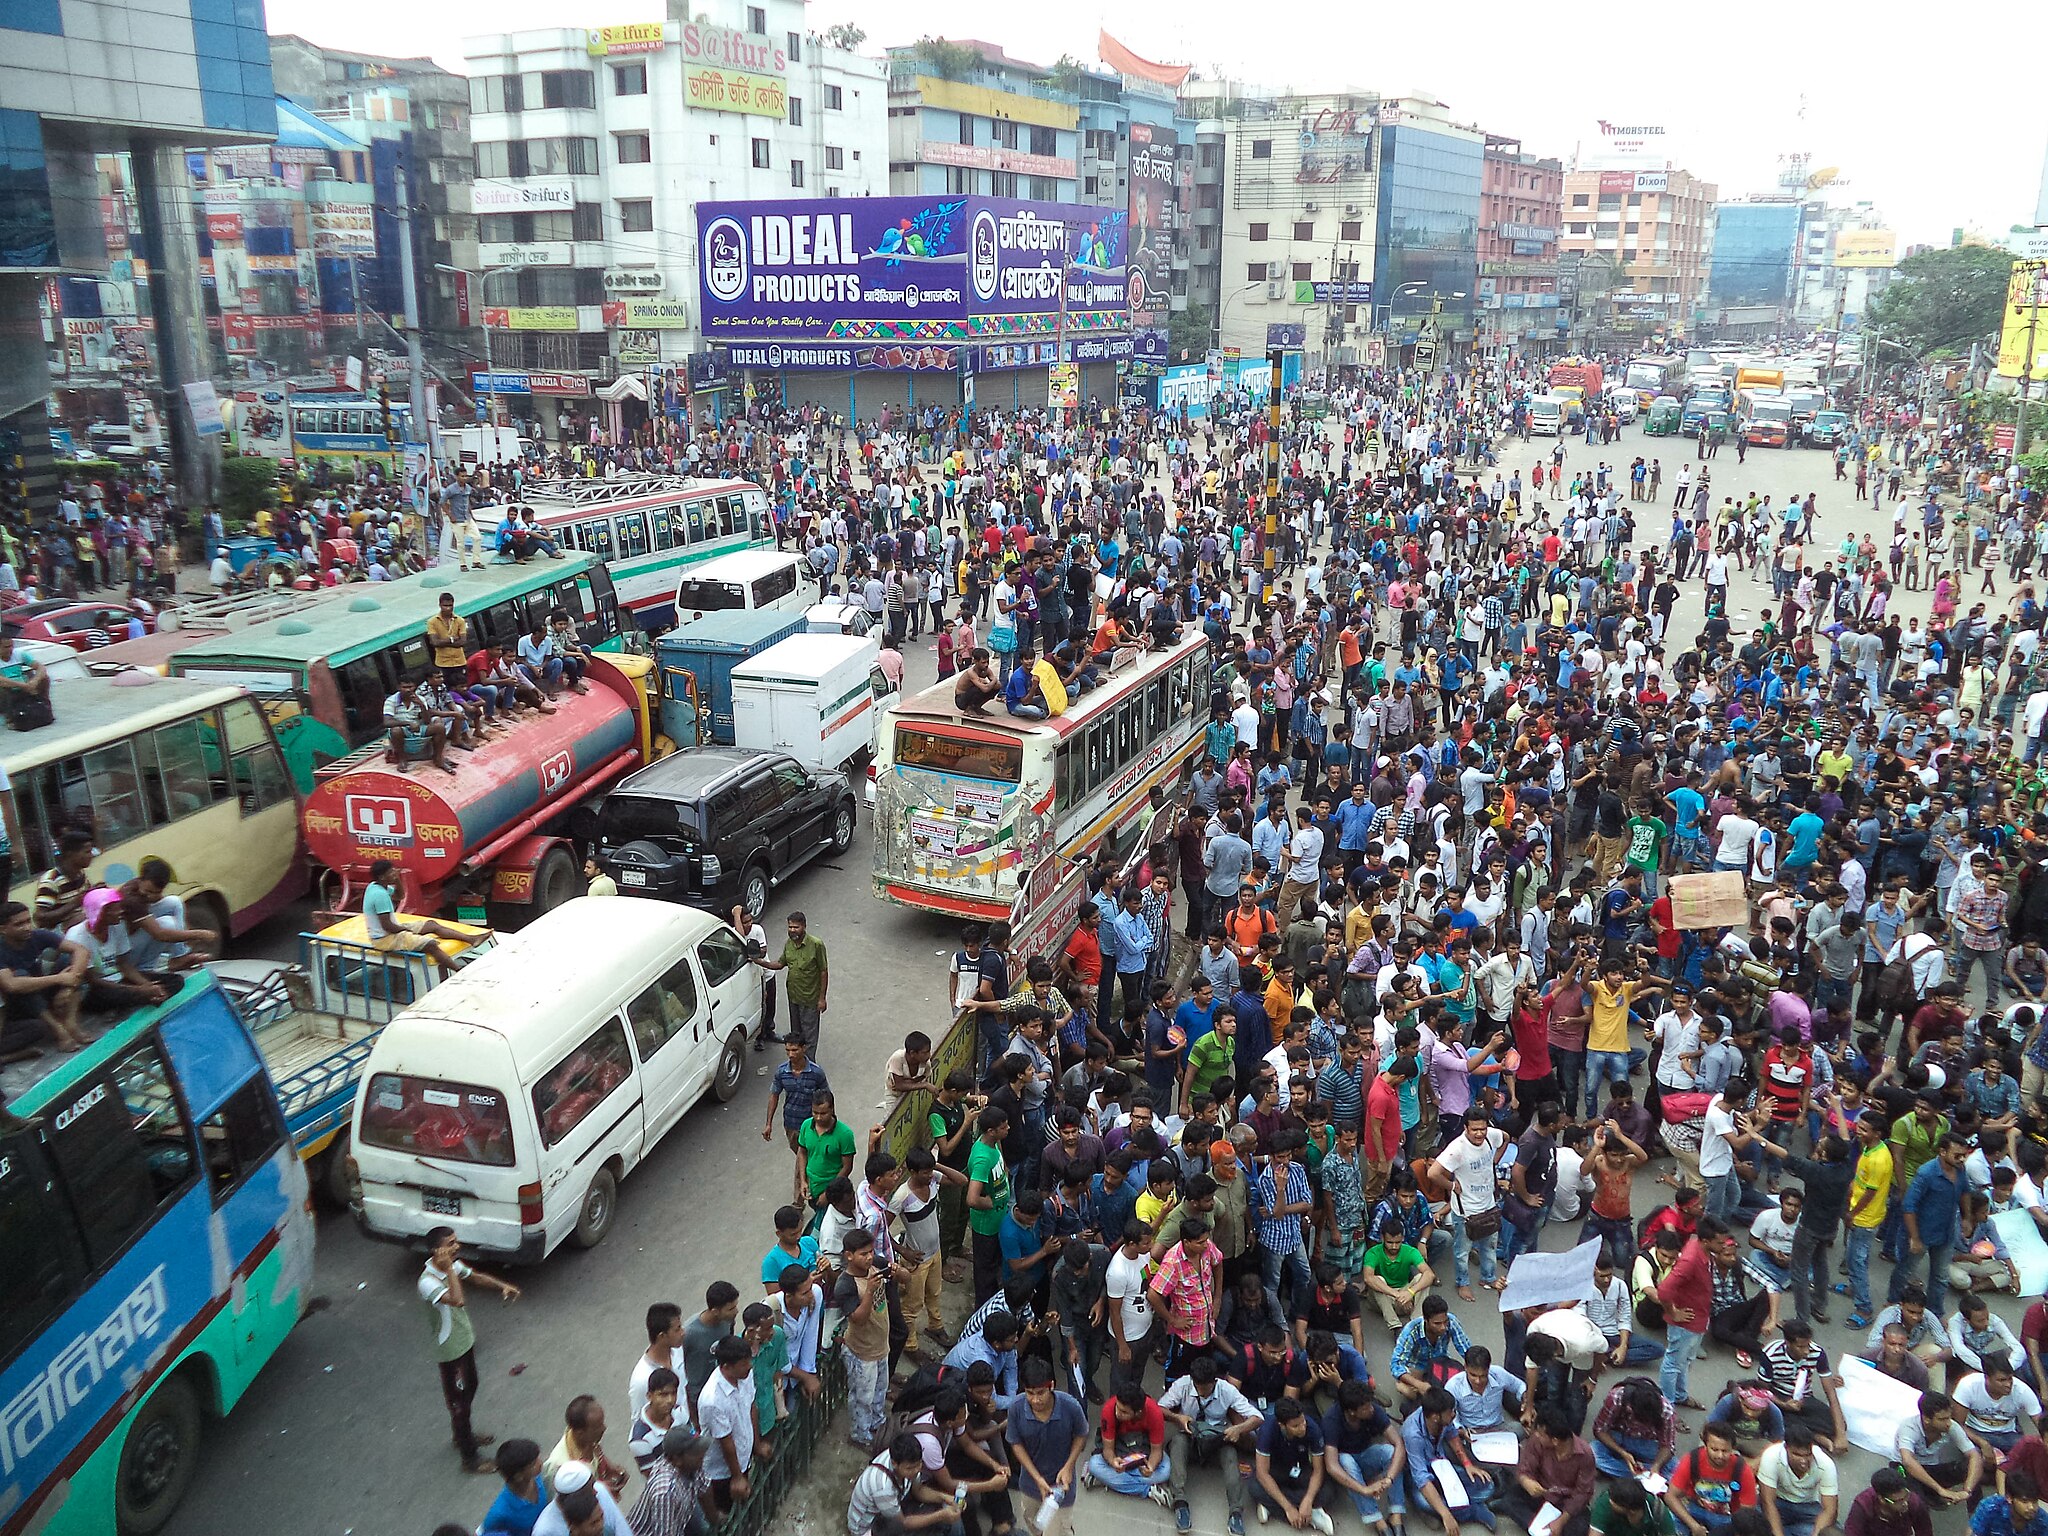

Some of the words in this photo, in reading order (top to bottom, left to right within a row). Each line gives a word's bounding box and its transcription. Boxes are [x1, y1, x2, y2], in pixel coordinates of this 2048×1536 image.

[684, 23, 786, 72] S@ifur's
[728, 76, 751, 106] ভর্তি
[755, 82, 786, 114] কোচিং
[1638, 176, 1667, 187] Dixon
[327, 203, 372, 215] Restaurant
[751, 213, 860, 266] IDEAL
[753, 274, 860, 302] PRODUCTS
[1067, 284, 1086, 302] IDEAL
[1093, 284, 1124, 302] PRODUCTS
[634, 305, 658, 317] SPRING
[660, 306, 684, 317] ONION
[67, 321, 103, 335] SALON
[712, 316, 730, 327] Send
[731, 316, 750, 327] Some
[752, 316, 765, 327] One
[765, 317, 779, 328] You
[781, 317, 804, 328] Really
[732, 349, 768, 365] IDEAL
[783, 349, 851, 366] PRODUCTS
[530, 377, 558, 387] MARZIA
[416, 823, 460, 843] জনক
[468, 1093, 497, 1104] ENOC
